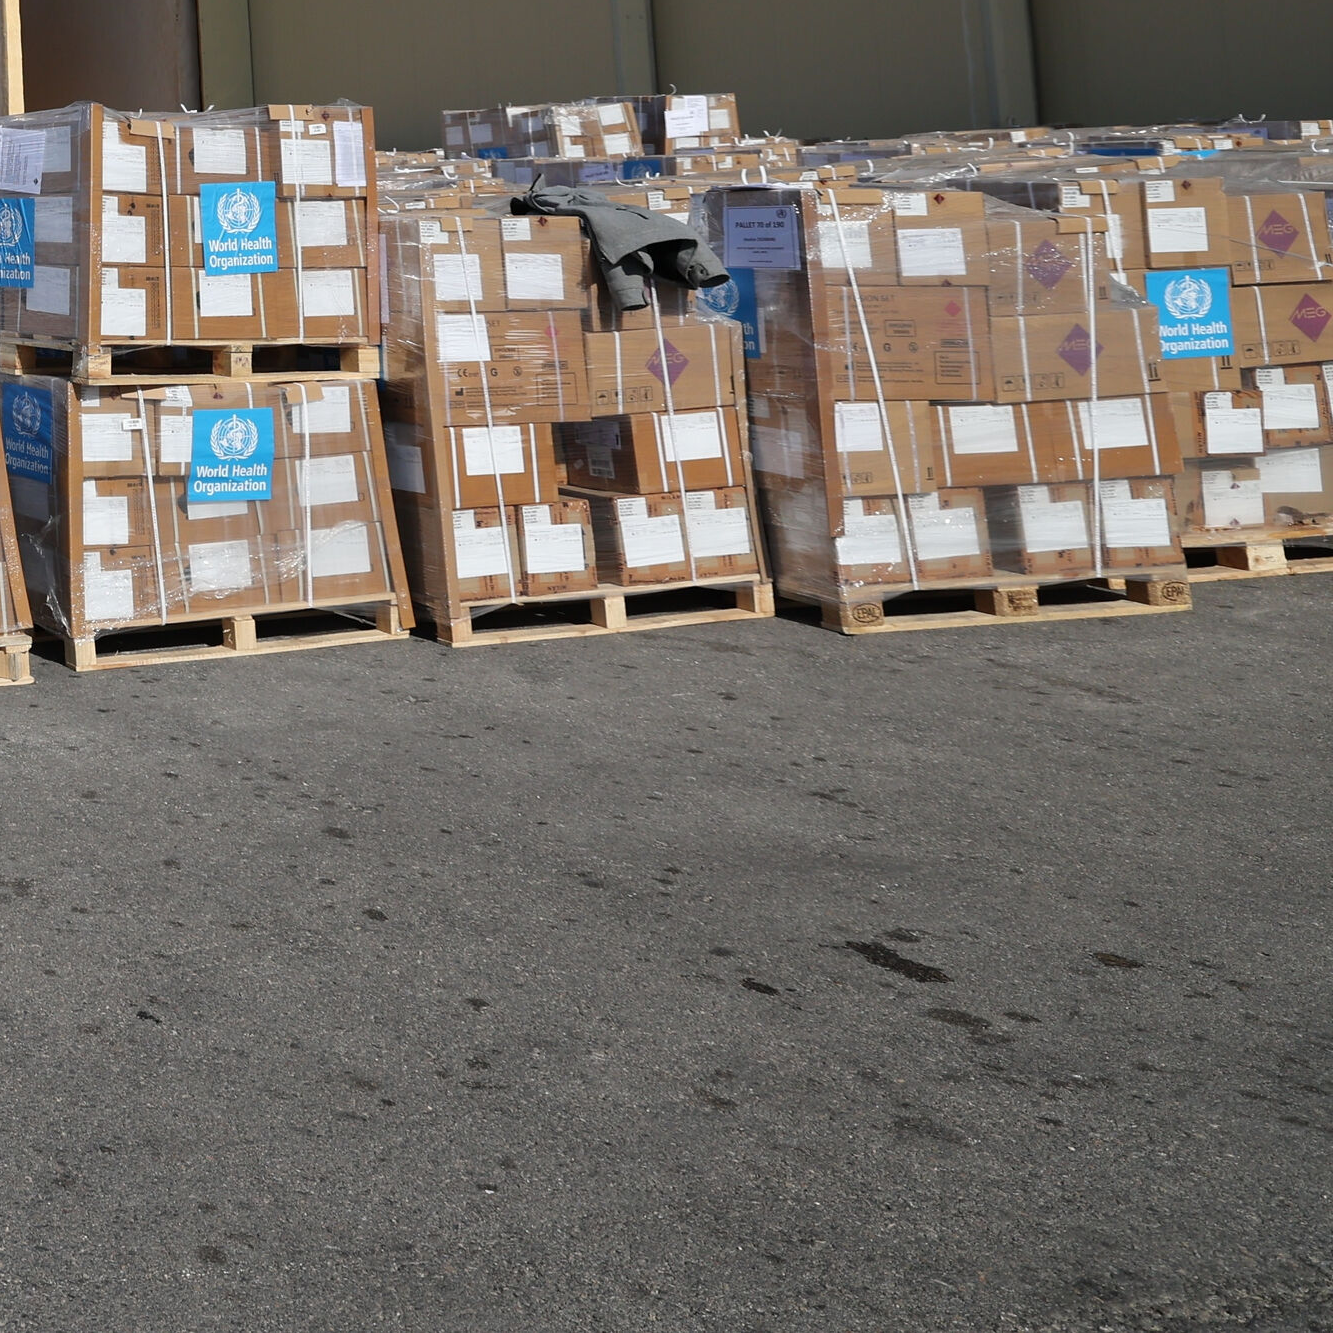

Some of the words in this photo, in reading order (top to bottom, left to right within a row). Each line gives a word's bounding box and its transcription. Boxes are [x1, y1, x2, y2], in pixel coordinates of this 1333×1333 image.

[1257, 223, 1294, 238] MEG
[209, 238, 237, 252] World
[241, 236, 272, 250] Health
[209, 253, 273, 270] Organization
[1291, 307, 1327, 320] MEG
[1159, 323, 1189, 337] World
[1192, 321, 1228, 335] Health
[490, 367, 498, 376] G
[5, 437, 25, 453] World
[26, 442, 49, 459] Health
[5, 453, 49, 474] Organization
[197, 464, 229, 478] World
[233, 463, 268, 476] Health
[193, 479, 267, 496] Organization
